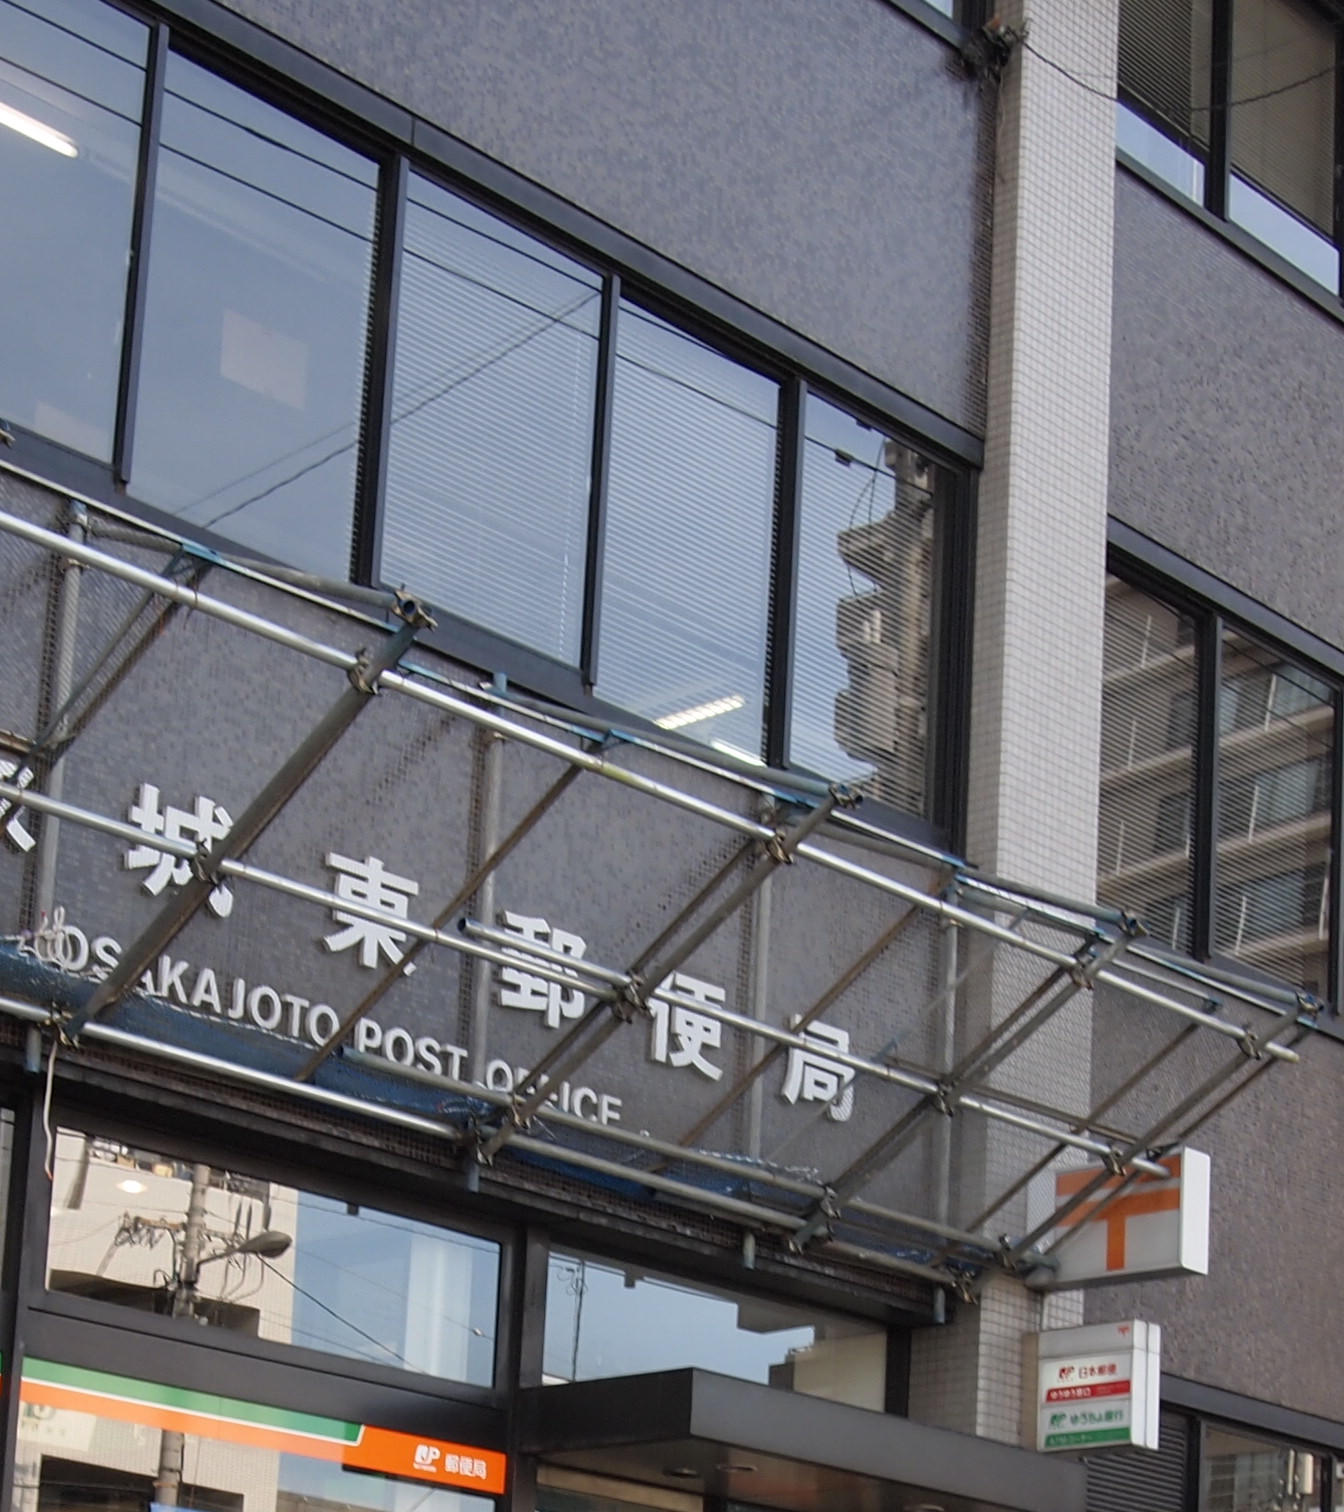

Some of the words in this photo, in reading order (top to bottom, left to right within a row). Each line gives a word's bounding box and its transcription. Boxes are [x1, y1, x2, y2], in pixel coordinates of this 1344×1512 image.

[356, 1016, 469, 1080] POST
[444, 1453, 488, 1480] 郵便局
